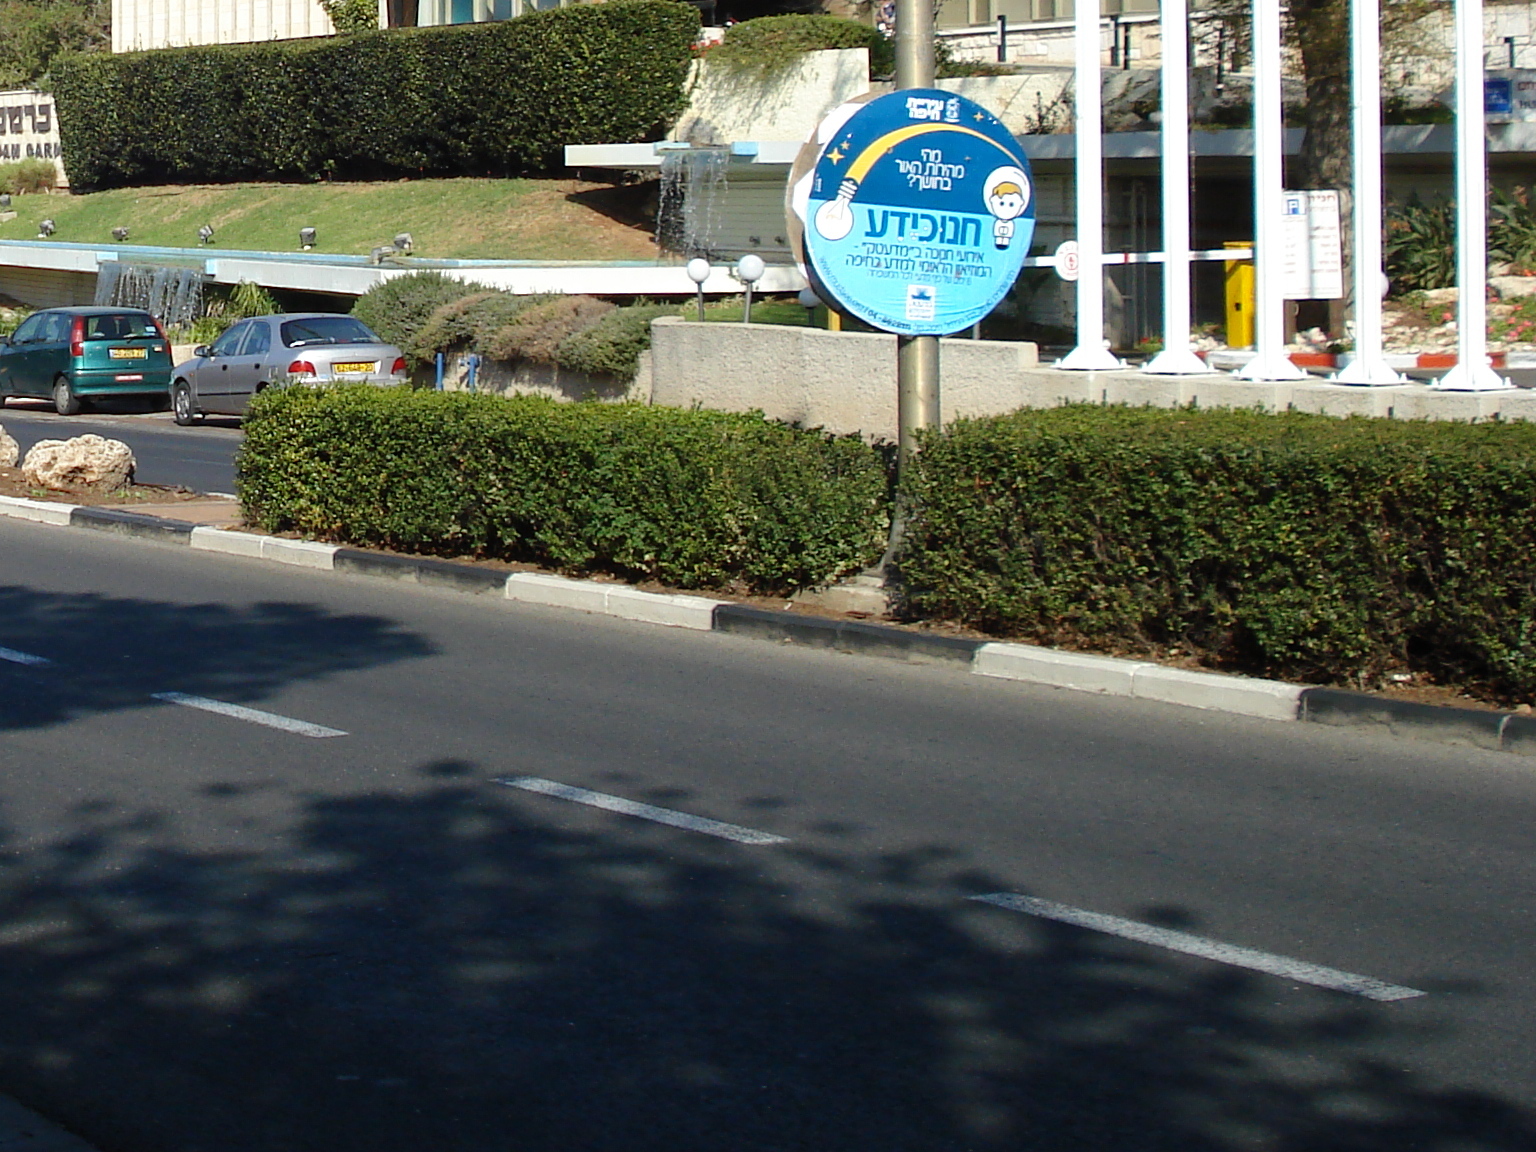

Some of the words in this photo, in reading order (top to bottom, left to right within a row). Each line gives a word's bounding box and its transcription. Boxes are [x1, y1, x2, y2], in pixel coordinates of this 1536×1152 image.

[909, 108, 941, 121] חיפה
[894, 158, 923, 175] האור
[906, 173, 952, 192] בחושך?
[864, 209, 983, 247] חנוכידע
[845, 254, 882, 269] בחיפה
[884, 257, 915, 272] למדע
